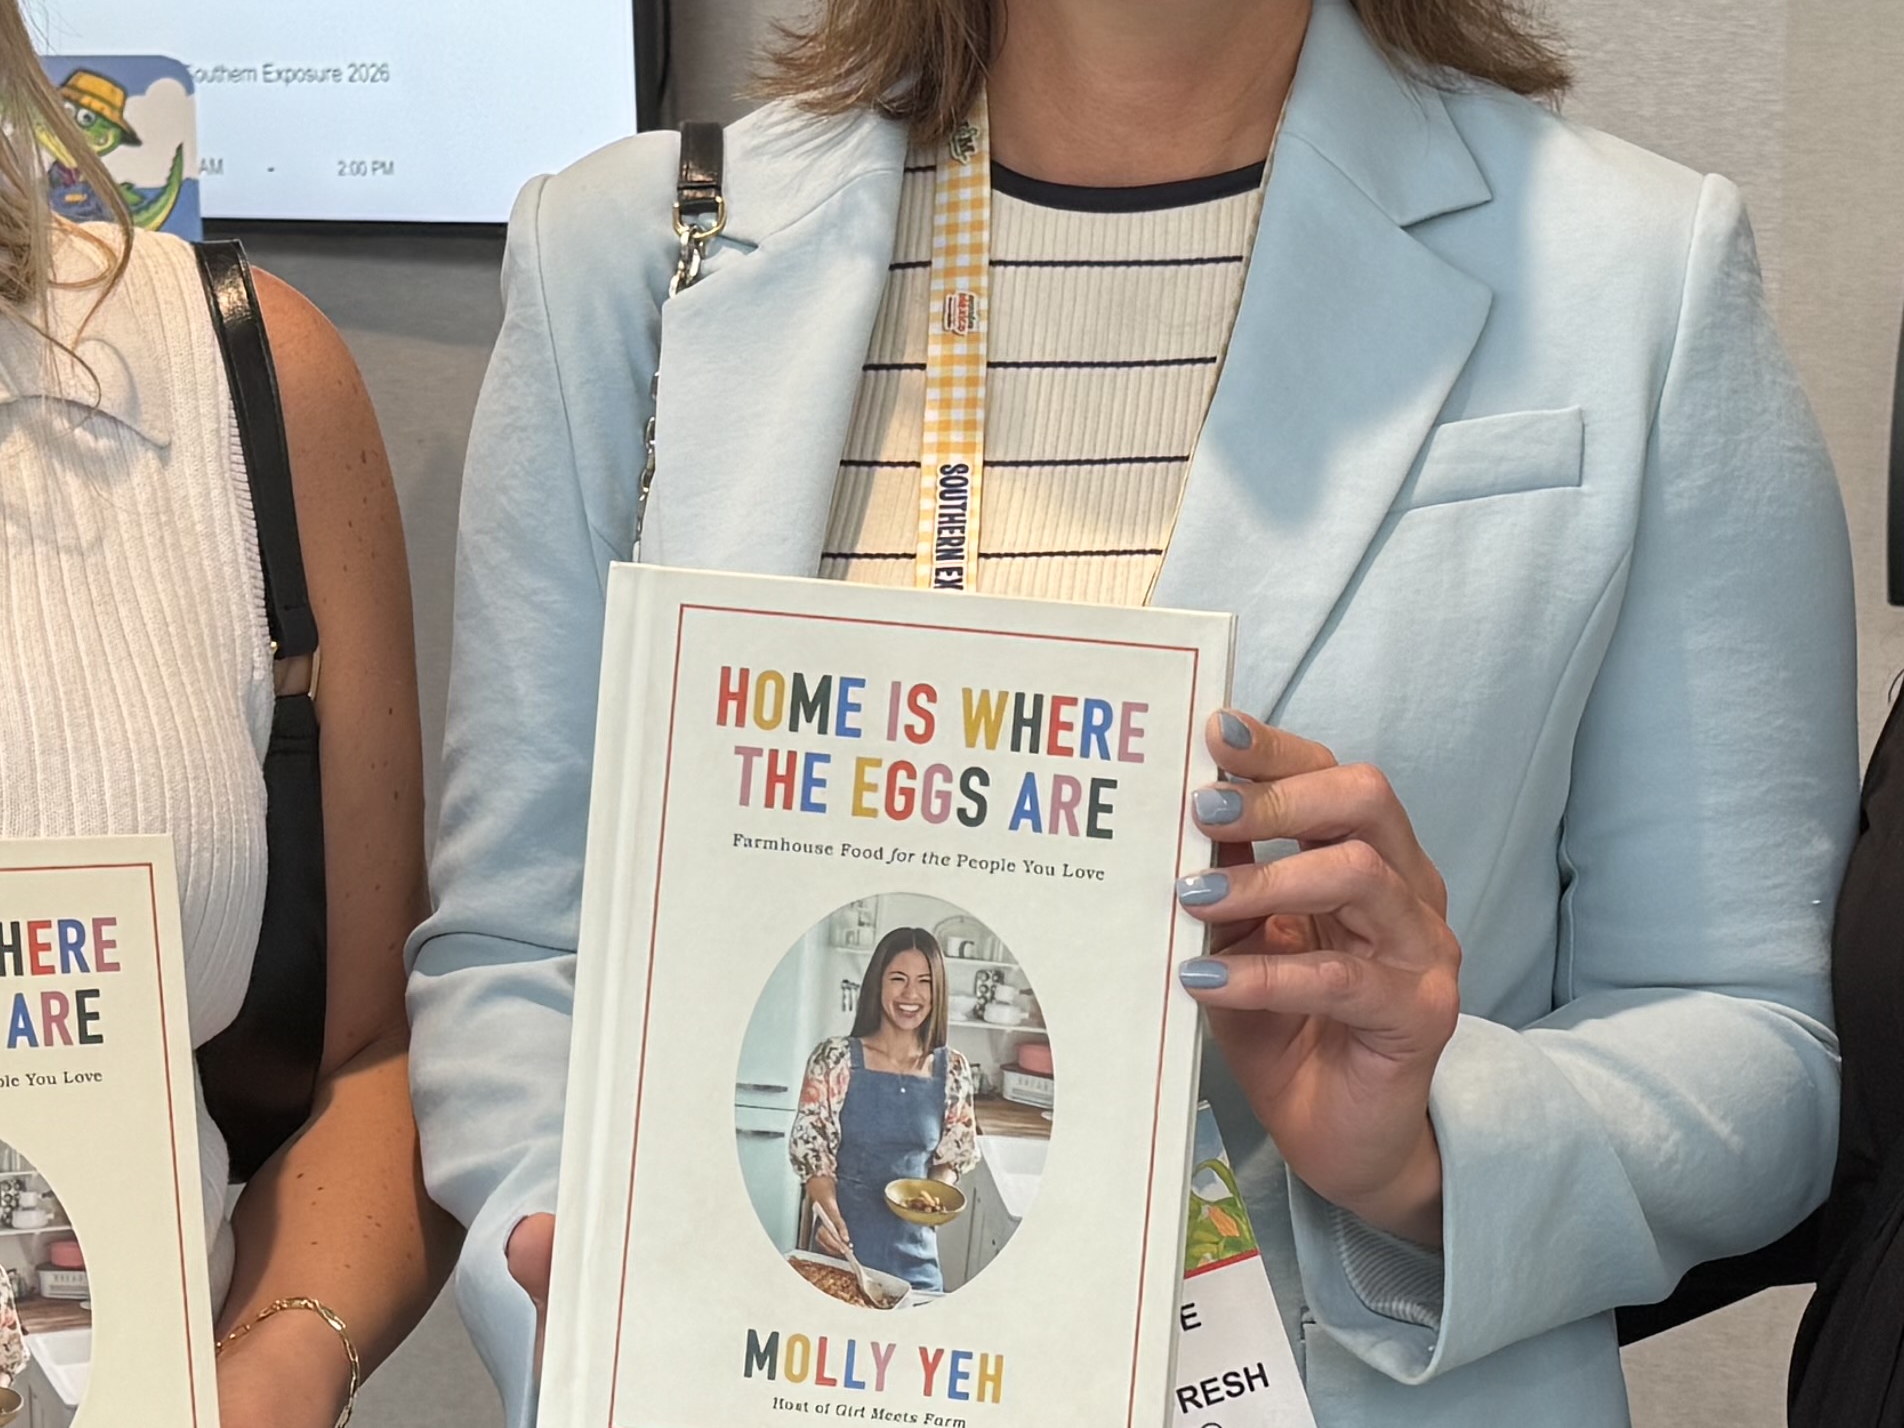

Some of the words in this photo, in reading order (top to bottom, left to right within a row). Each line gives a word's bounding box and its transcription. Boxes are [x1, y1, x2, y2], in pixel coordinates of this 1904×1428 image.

[261, 64, 343, 85] Exposure
[348, 64, 391, 82] 2026
[199, 158, 224, 175] AM
[337, 160, 368, 177] 2:00
[371, 160, 395, 176] PM
[935, 463, 970, 564] SOUTHERN
[716, 665, 866, 738] HOME
[886, 680, 937, 744] IS
[961, 687, 1149, 764] WHERE
[734, 745, 831, 814] THE
[851, 756, 990, 828] EGGS
[1008, 771, 1118, 840] ARE
[732, 833, 834, 857] Farmhouse
[840, 842, 884, 861] Food
[886, 847, 915, 865] for
[921, 850, 951, 867] the
[956, 854, 1016, 875] People
[1023, 859, 1056, 877] You
[1062, 863, 1105, 881] Love
[7, 988, 104, 1050] ARE
[25, 1072, 57, 1087] You
[63, 1070, 103, 1084] Love
[743, 1329, 897, 1392] MOLLY
[918, 1346, 1004, 1405] YEH
[1175, 1362, 1270, 1414] RESH
[772, 1397, 809, 1414] Host
[815, 1403, 832, 1415] of
[836, 1404, 866, 1419] Girl
[871, 1408, 919, 1425] Meets
